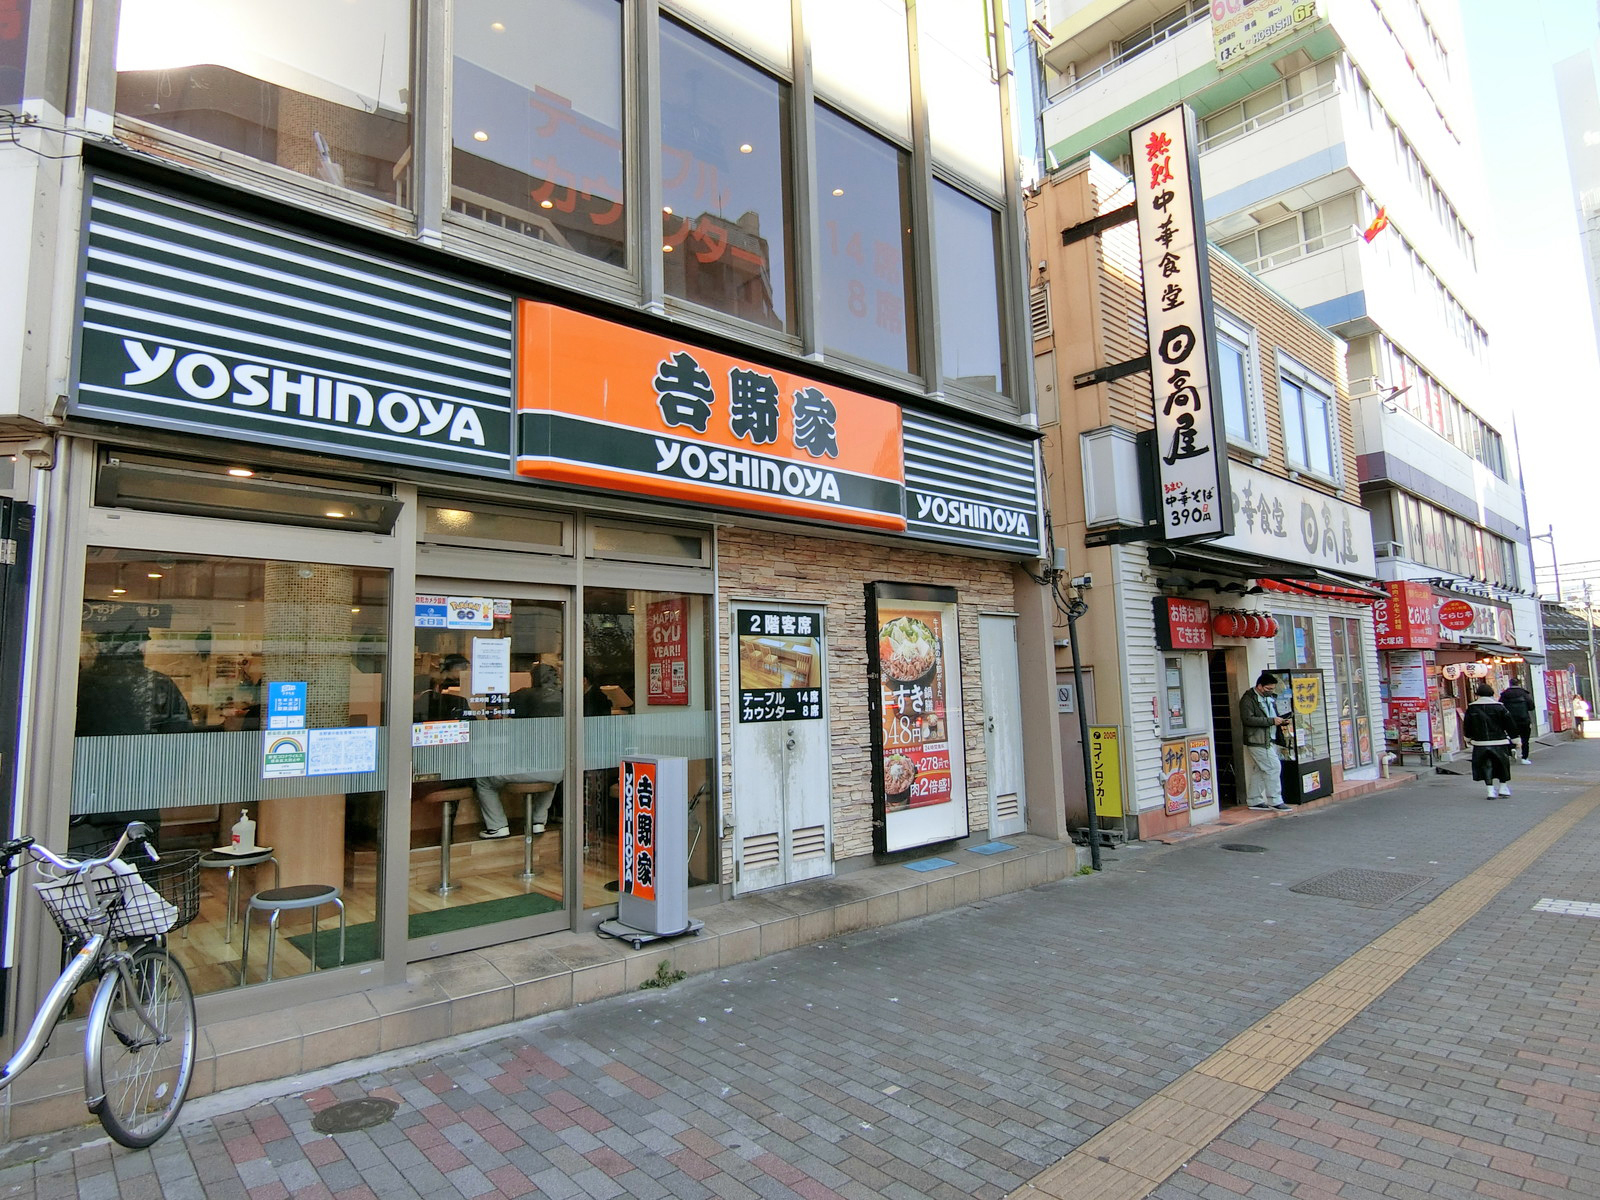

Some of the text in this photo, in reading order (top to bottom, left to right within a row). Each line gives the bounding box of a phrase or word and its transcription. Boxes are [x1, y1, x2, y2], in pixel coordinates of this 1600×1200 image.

[1292, 1, 1317, 23] 6F
[1252, 15, 1292, 44] HOGUSHI
[1220, 42, 1246, 61] ほぐし
[122, 340, 486, 447] YOSHINOYA
[1158, 324, 1209, 466] 日高屋
[652, 350, 840, 460] 吉野家
[655, 438, 840, 502] YOSHINOYA
[1165, 486, 1215, 507] 中華そば
[915, 493, 1030, 537] YOSHINOYA
[1171, 507, 1212, 526] 390円
[1301, 500, 1359, 565] 日高屋
[457, 610, 475, 620] GO
[653, 609, 680, 625] HAPPY
[1170, 604, 1209, 623] お持ち帰り
[653, 625, 681, 643] GYU
[750, 614, 812, 635] 2階客席
[1176, 626, 1207, 643] できます
[653, 644, 681, 658] YEAR!!
[742, 690, 819, 706] テーブル 14席
[743, 705, 819, 720] カウンター 8席
[1093, 742, 1105, 806] コインロッカー
[624, 773, 633, 881] YOSHINOYA
[636, 774, 654, 888] 吉野家
